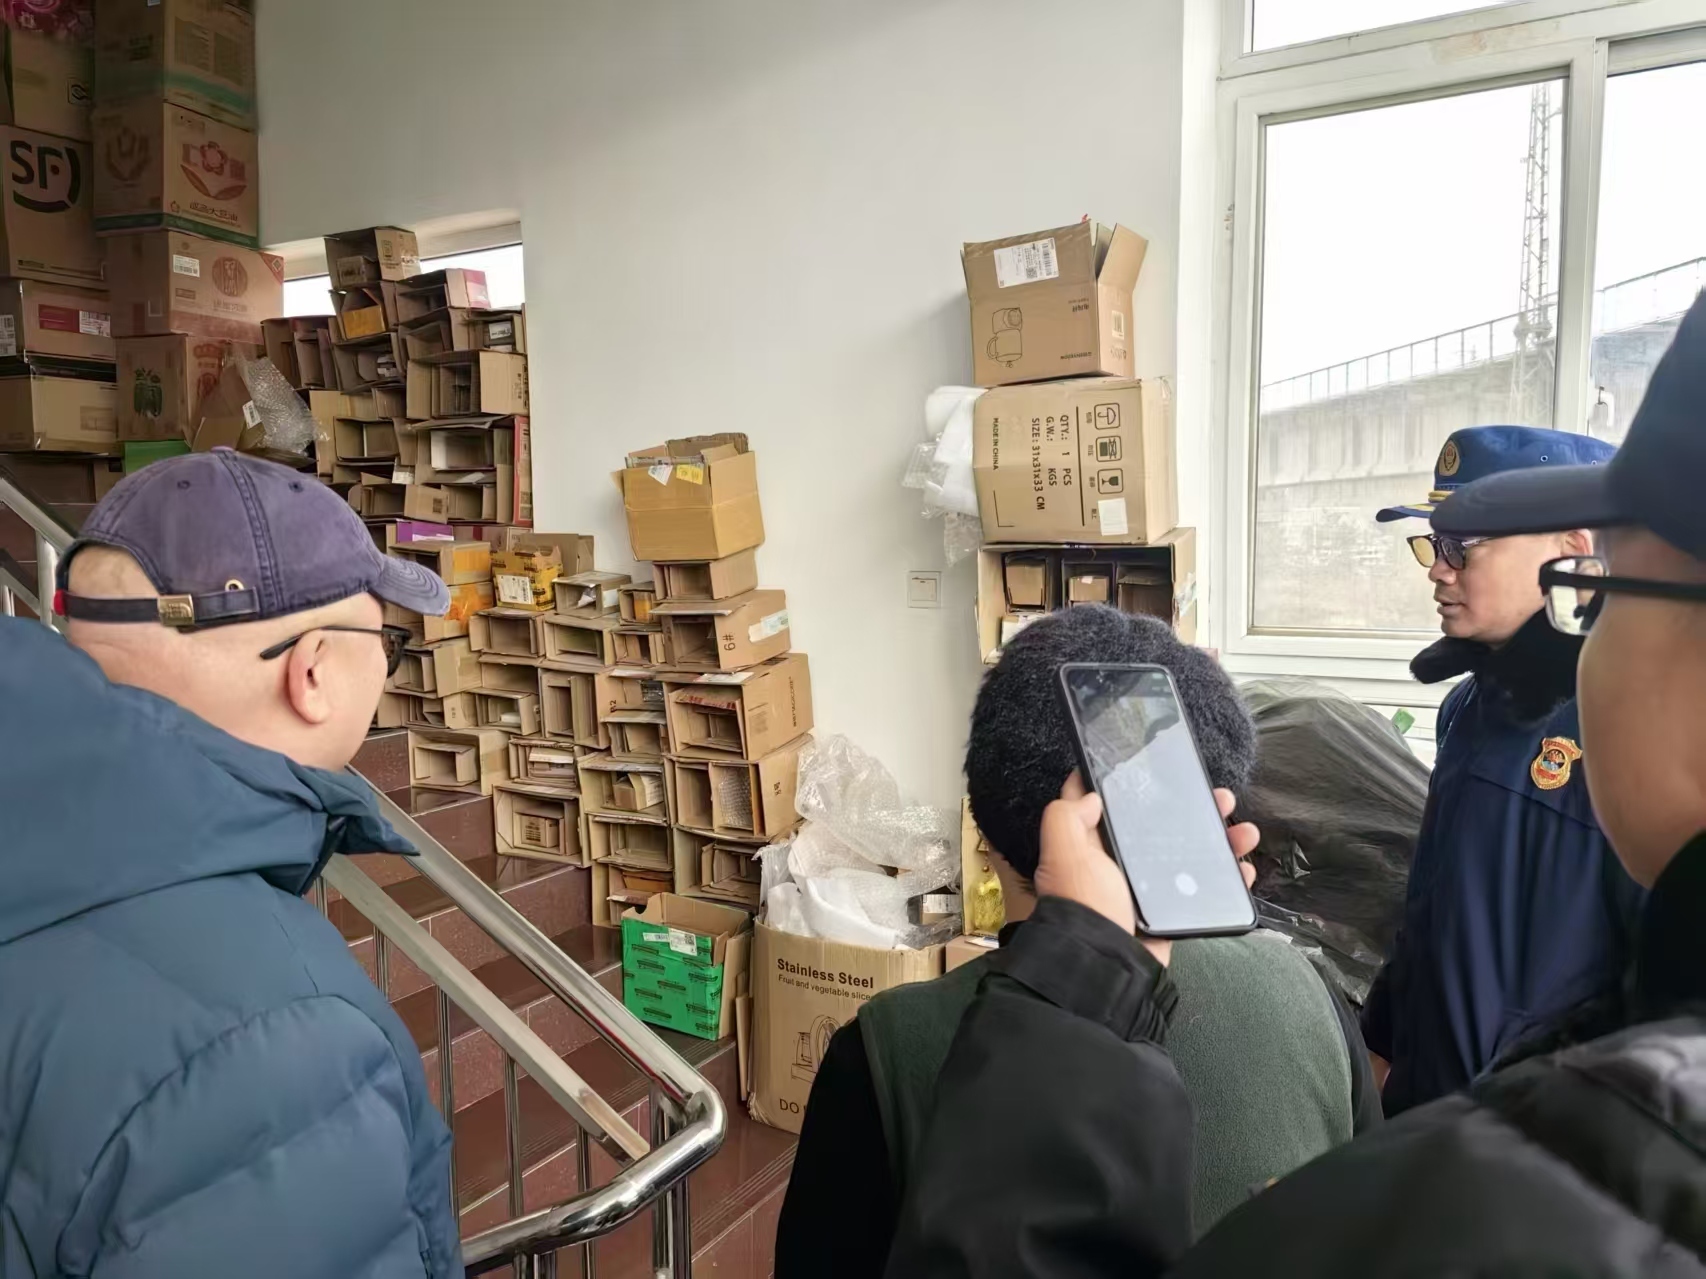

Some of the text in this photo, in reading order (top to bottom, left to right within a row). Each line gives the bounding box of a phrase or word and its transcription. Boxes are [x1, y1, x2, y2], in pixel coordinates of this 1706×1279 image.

[1060, 414, 1069, 440] QTY.:
[1046, 416, 1057, 486] G.W.: KGS
[1063, 468, 1072, 486] PCS
[1036, 496, 1045, 511] CM
[777, 958, 874, 989] Stainless Steel
[778, 973, 872, 1001] Fruit and vegetable slice
[779, 1098, 800, 1114] DO
